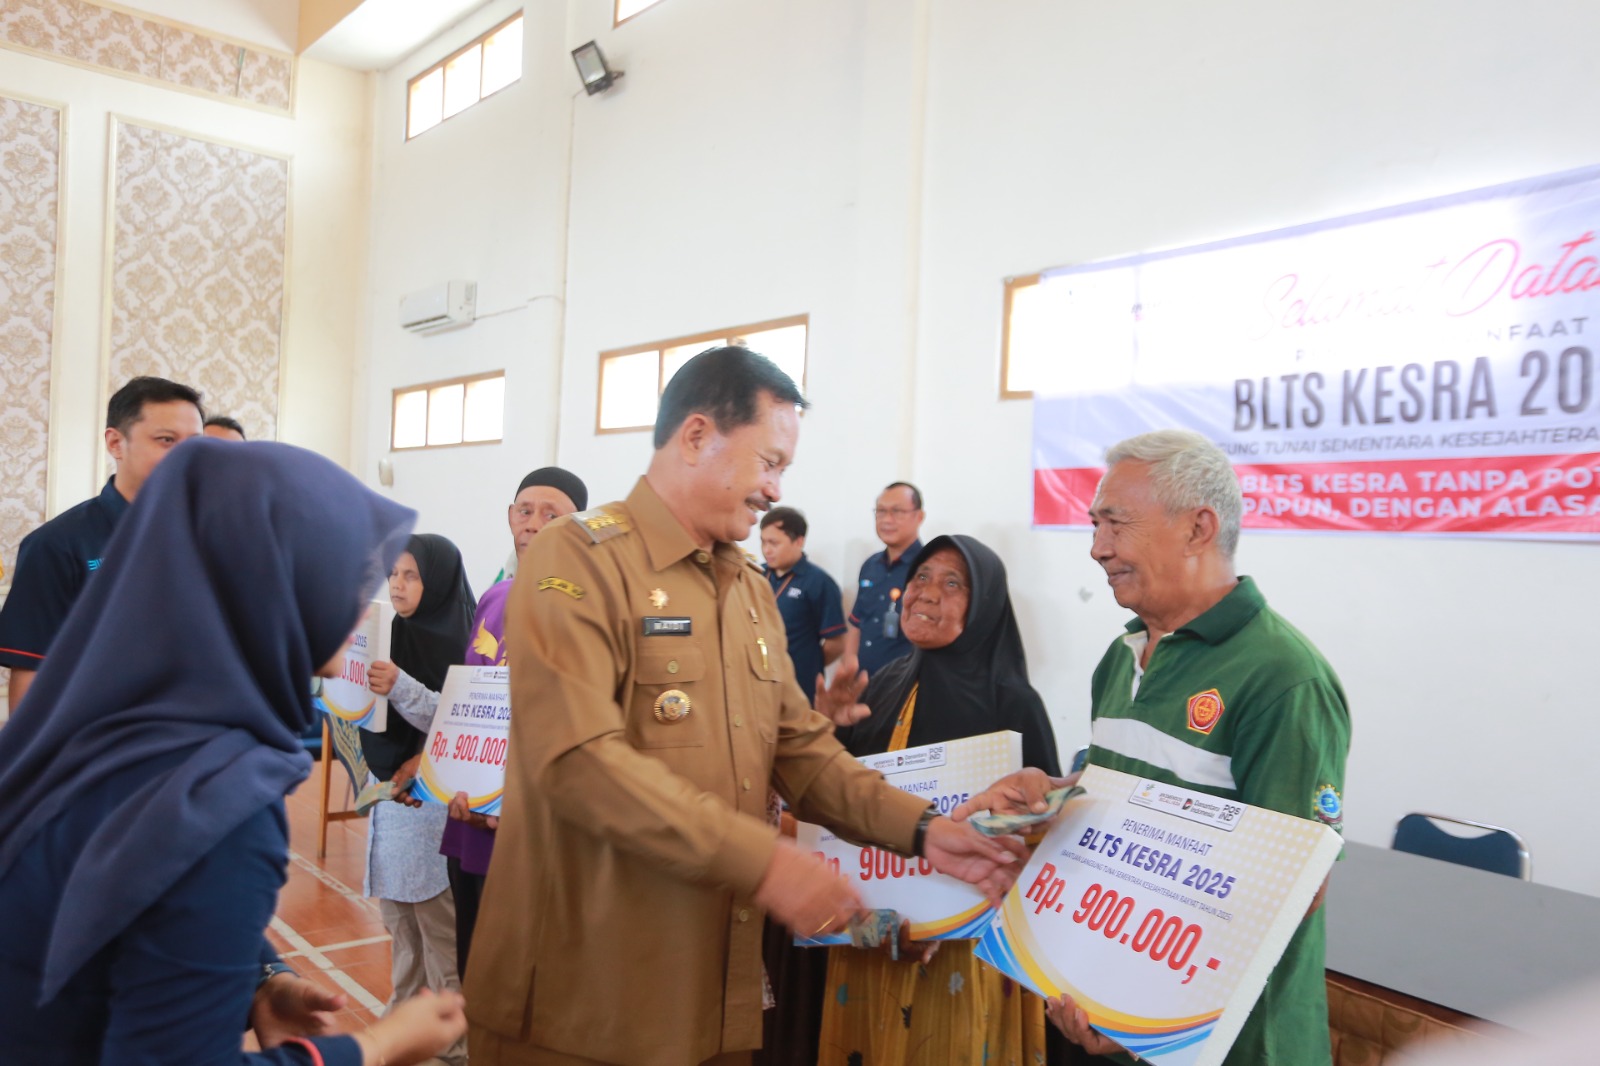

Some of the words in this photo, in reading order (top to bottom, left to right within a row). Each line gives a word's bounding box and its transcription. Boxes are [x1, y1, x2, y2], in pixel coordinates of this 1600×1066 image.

[1233, 372, 1326, 431] BLTS
[1342, 356, 1497, 426] KESRA
[1265, 440, 1316, 454] TUNAI
[1320, 433, 1434, 452] SEMENTARA
[1242, 473, 1304, 493] BLTS
[1312, 471, 1407, 493] KESRA
[1416, 469, 1529, 492] TANPA
[1351, 496, 1482, 518] DENGAN
[451, 704, 470, 717] BLTS
[471, 705, 495, 719] KESRA
[430, 731, 448, 762] Rp.
[1122, 818, 1168, 843] PENERIMA
[1165, 832, 1213, 856] MANFAAT
[1078, 827, 1123, 858] BLTS
[1121, 842, 1183, 880] KESRA
[1183, 864, 1237, 899] 2025
[1025, 862, 1065, 914] Rp.
[1072, 883, 1221, 984] 900.000,-
